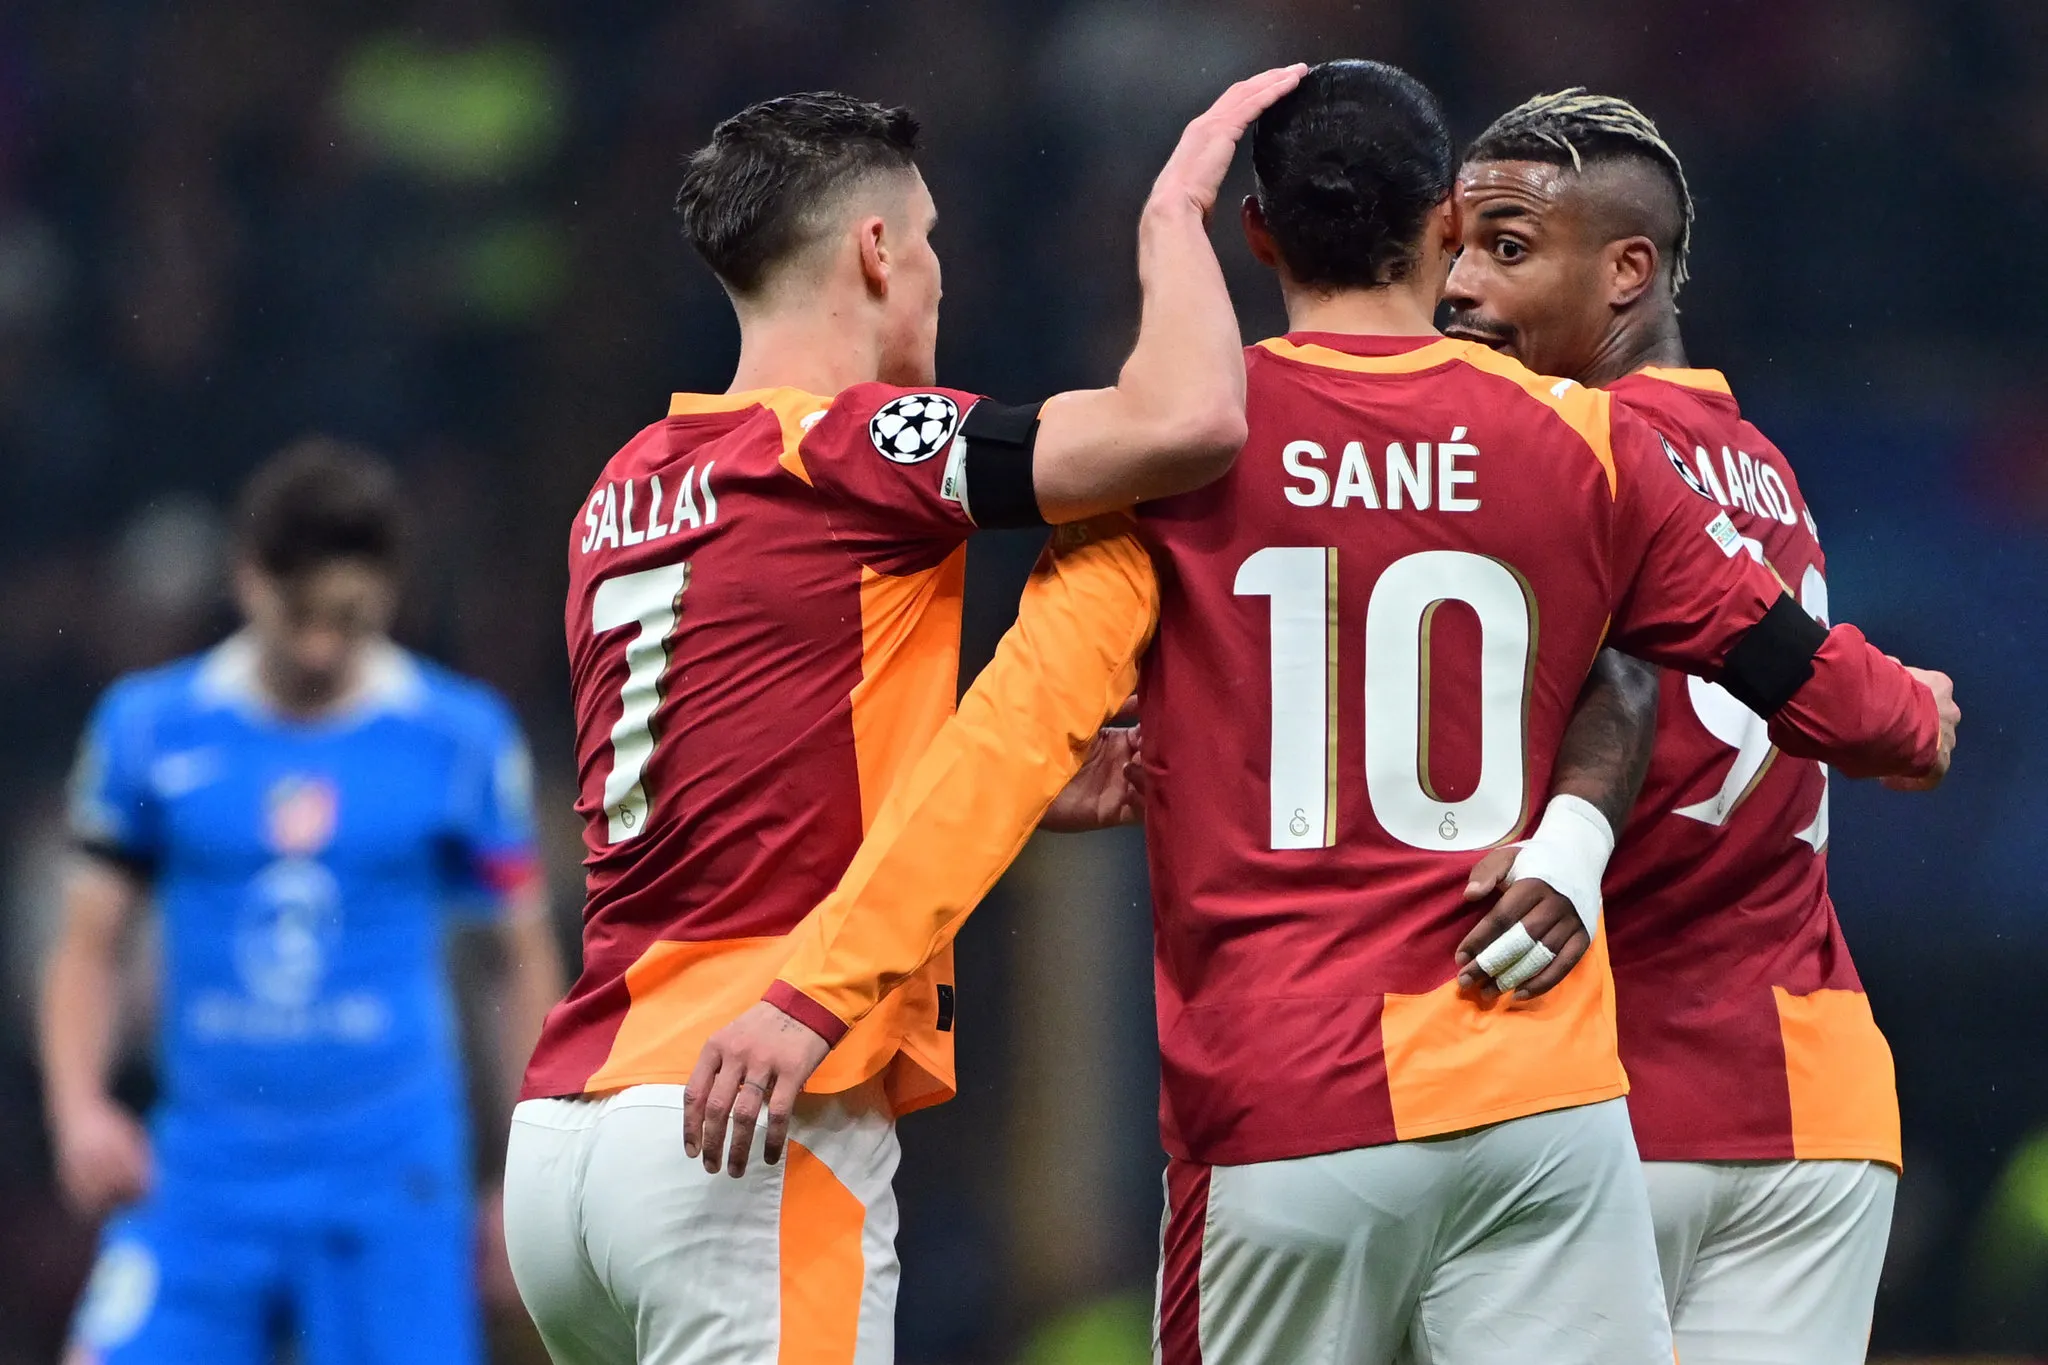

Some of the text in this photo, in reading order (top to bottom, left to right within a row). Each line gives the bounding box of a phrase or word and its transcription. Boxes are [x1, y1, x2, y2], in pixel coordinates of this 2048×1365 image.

[582, 460, 718, 554] SALLAI
[1281, 426, 1481, 512] SANÉ
[1695, 445, 1798, 525] MARIO
[592, 561, 692, 846] 7
[1233, 546, 1540, 852] 10
